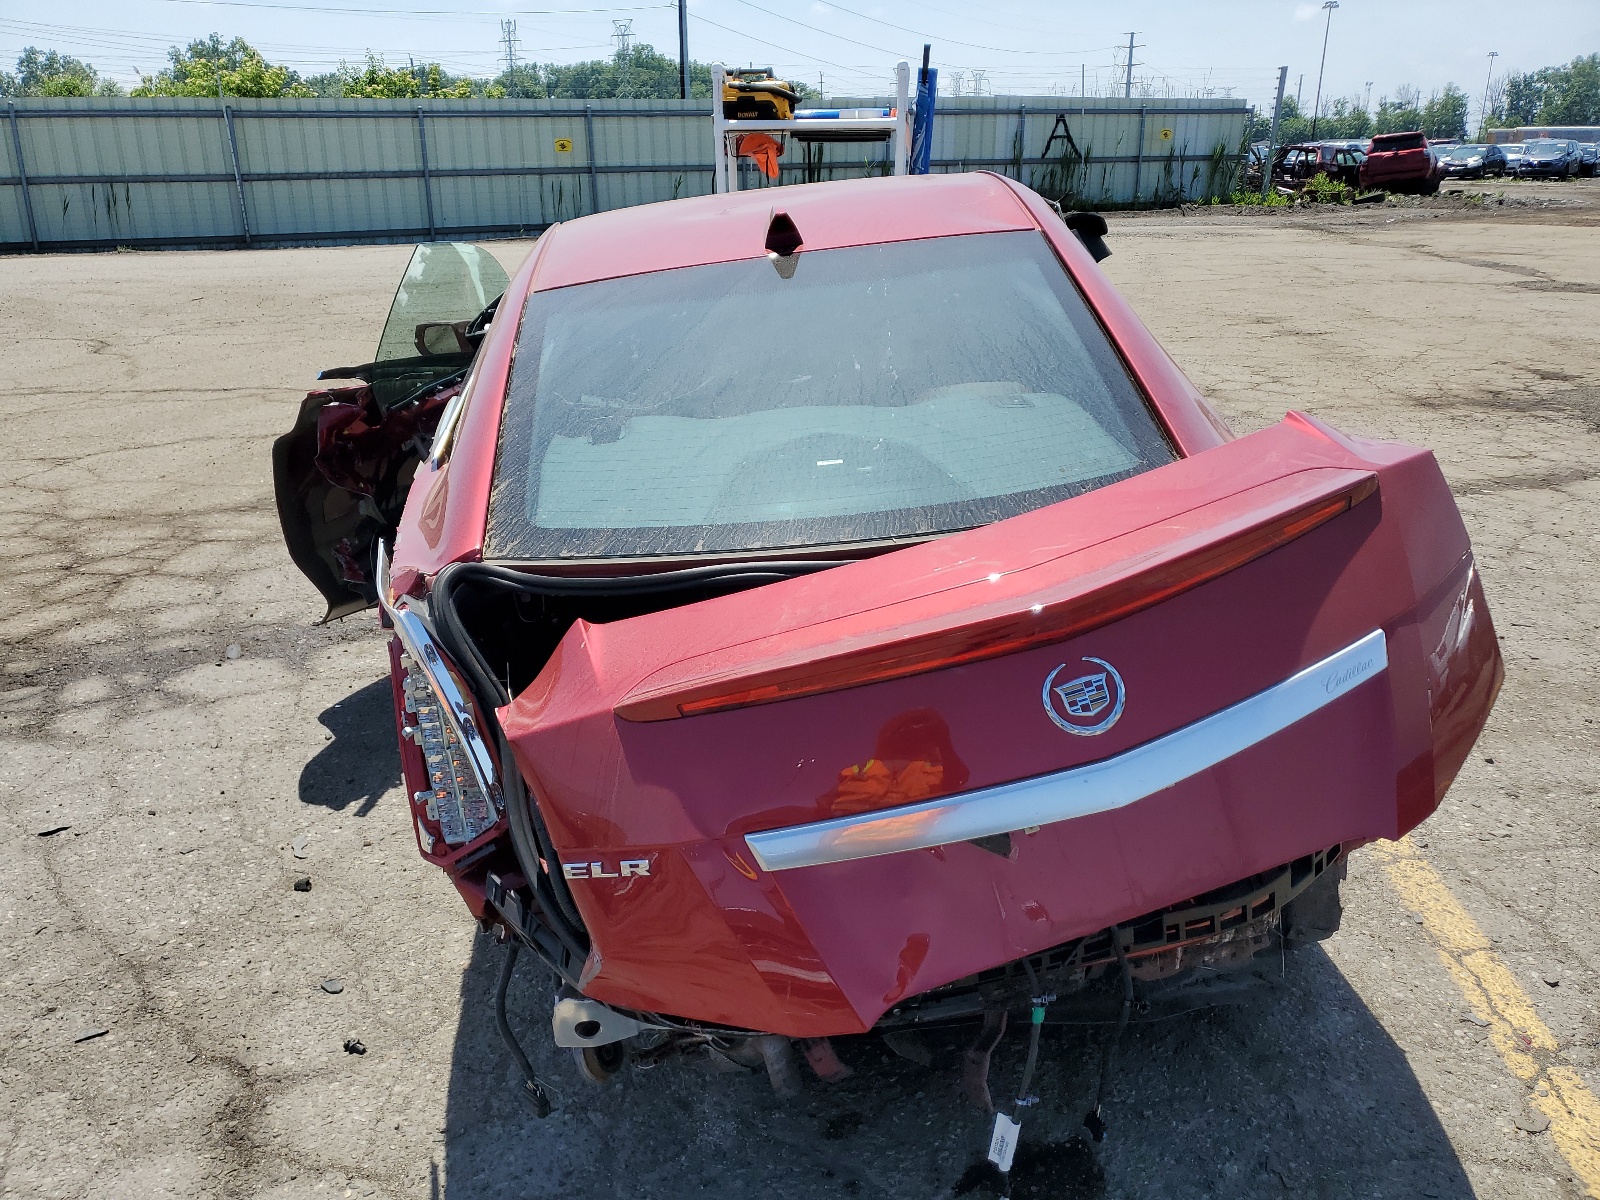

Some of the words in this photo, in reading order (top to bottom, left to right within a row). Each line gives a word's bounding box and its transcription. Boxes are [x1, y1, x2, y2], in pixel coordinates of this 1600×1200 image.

[1041, 113, 1082, 159] A
[1321, 658, 1374, 694] Cadillac
[562, 859, 651, 880] ELR
